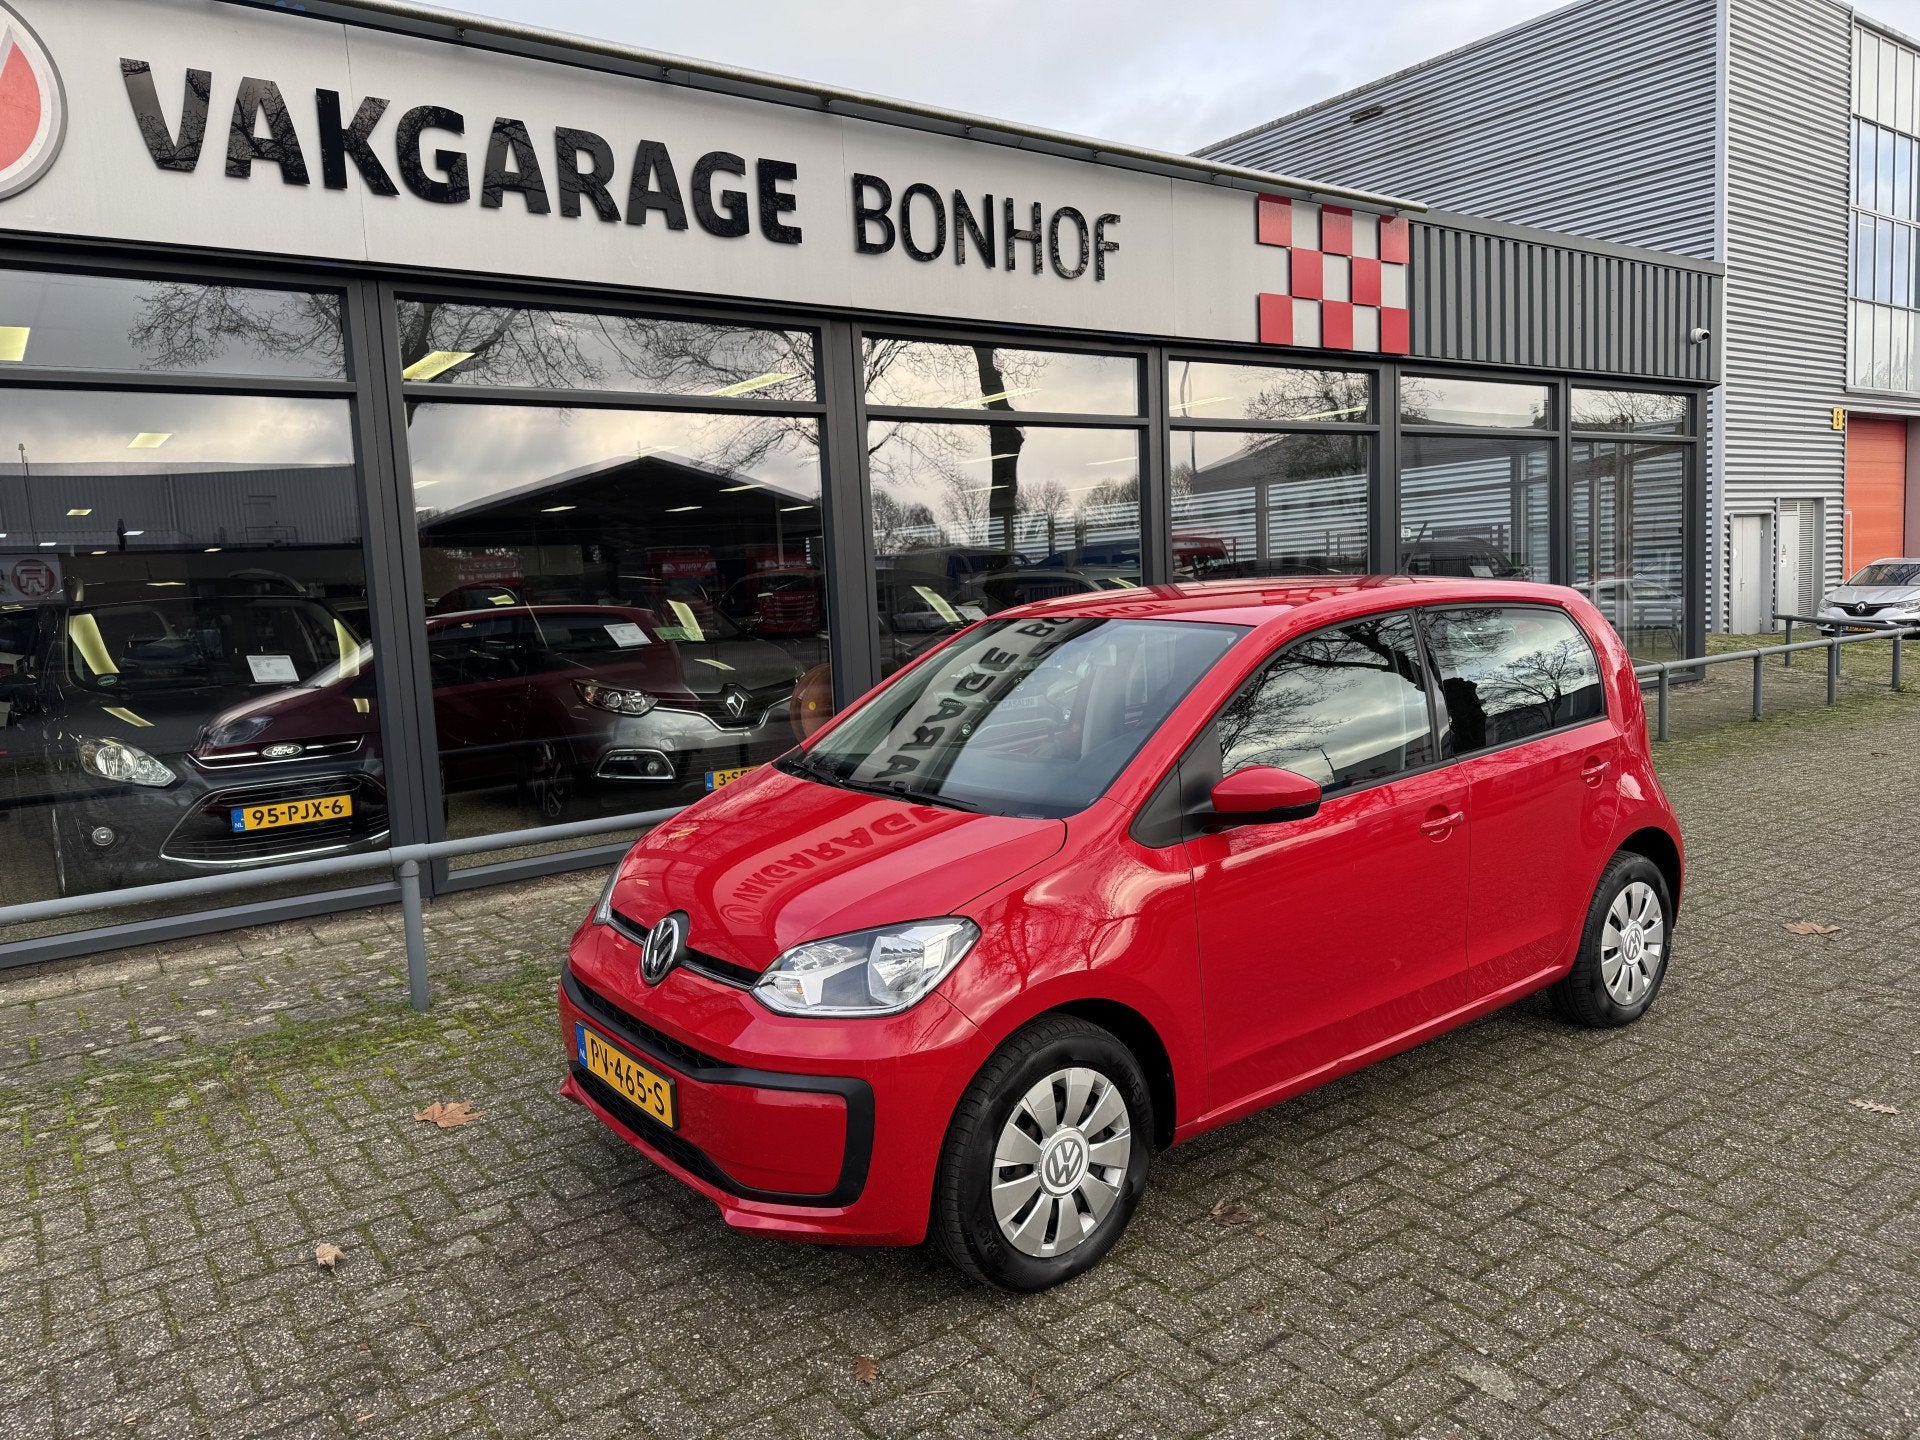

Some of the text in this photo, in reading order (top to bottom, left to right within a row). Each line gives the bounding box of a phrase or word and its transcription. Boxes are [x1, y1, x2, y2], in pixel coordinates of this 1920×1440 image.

[119, 57, 1121, 282] VAKGARAGE BONHOF
[252, 799, 344, 826] 95-PJX-6
[590, 1037, 665, 1116] PV-465-S
